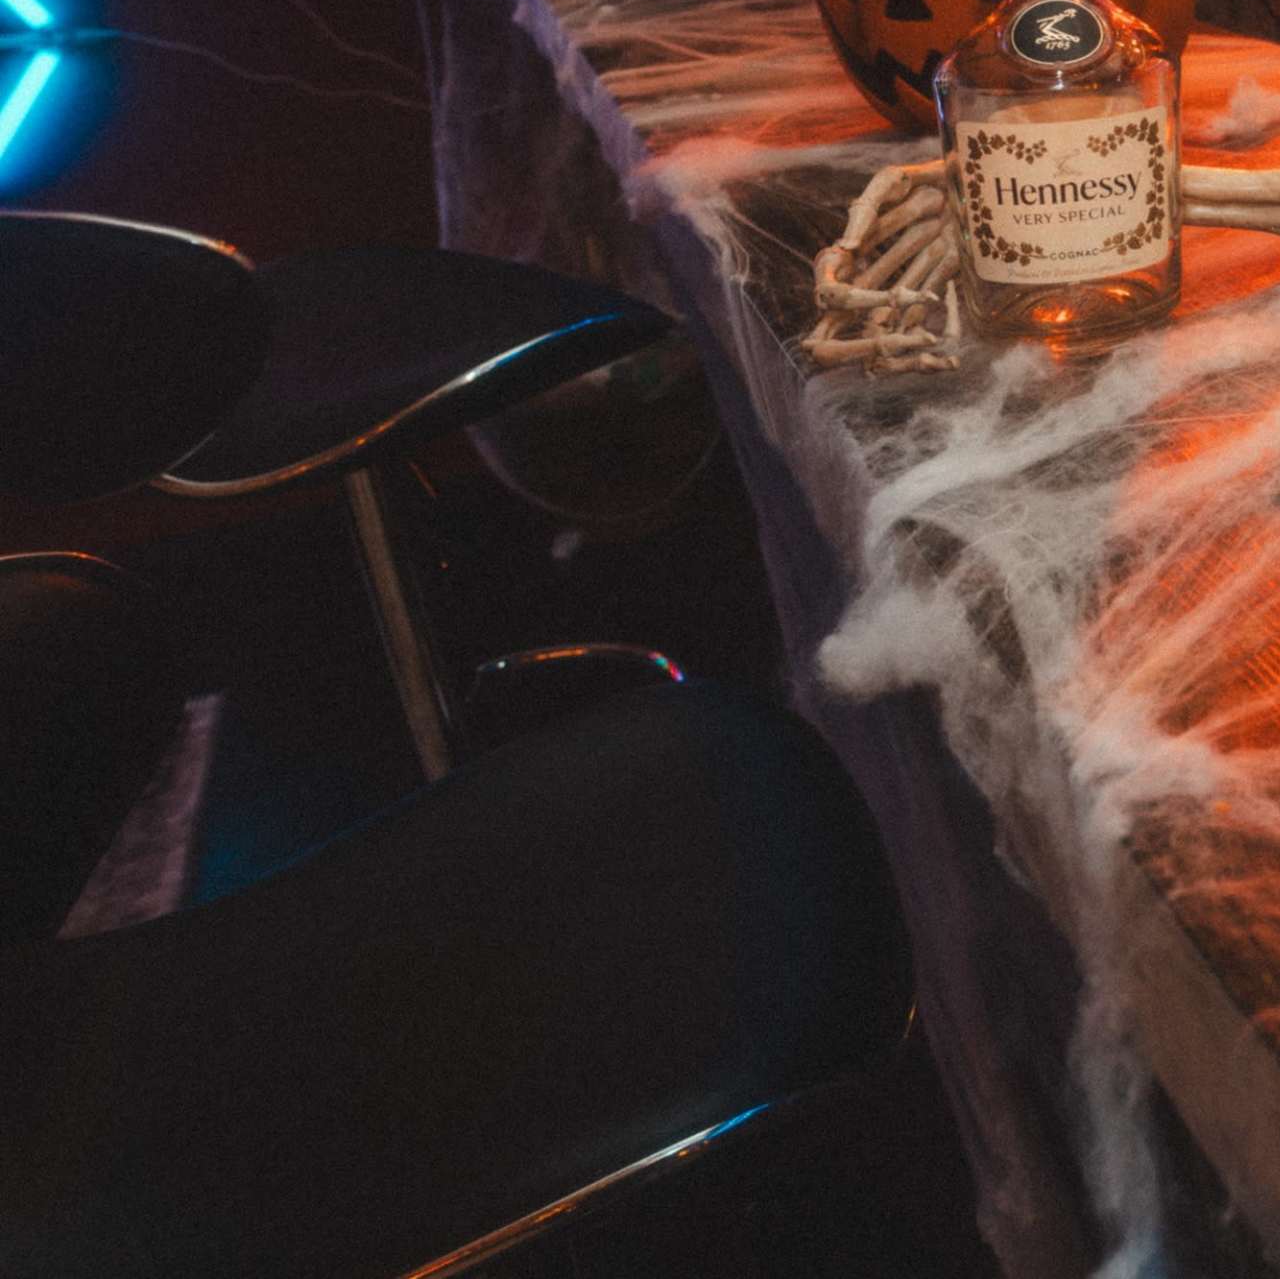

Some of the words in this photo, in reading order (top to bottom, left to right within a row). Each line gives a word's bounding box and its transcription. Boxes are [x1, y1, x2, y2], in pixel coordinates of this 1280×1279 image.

[1044, 40, 1071, 51] 1765
[993, 170, 1142, 206] Hennessy
[1012, 212, 1053, 226] VERY
[1058, 204, 1126, 224] SPECIAL
[1050, 248, 1100, 261] COGNAC
